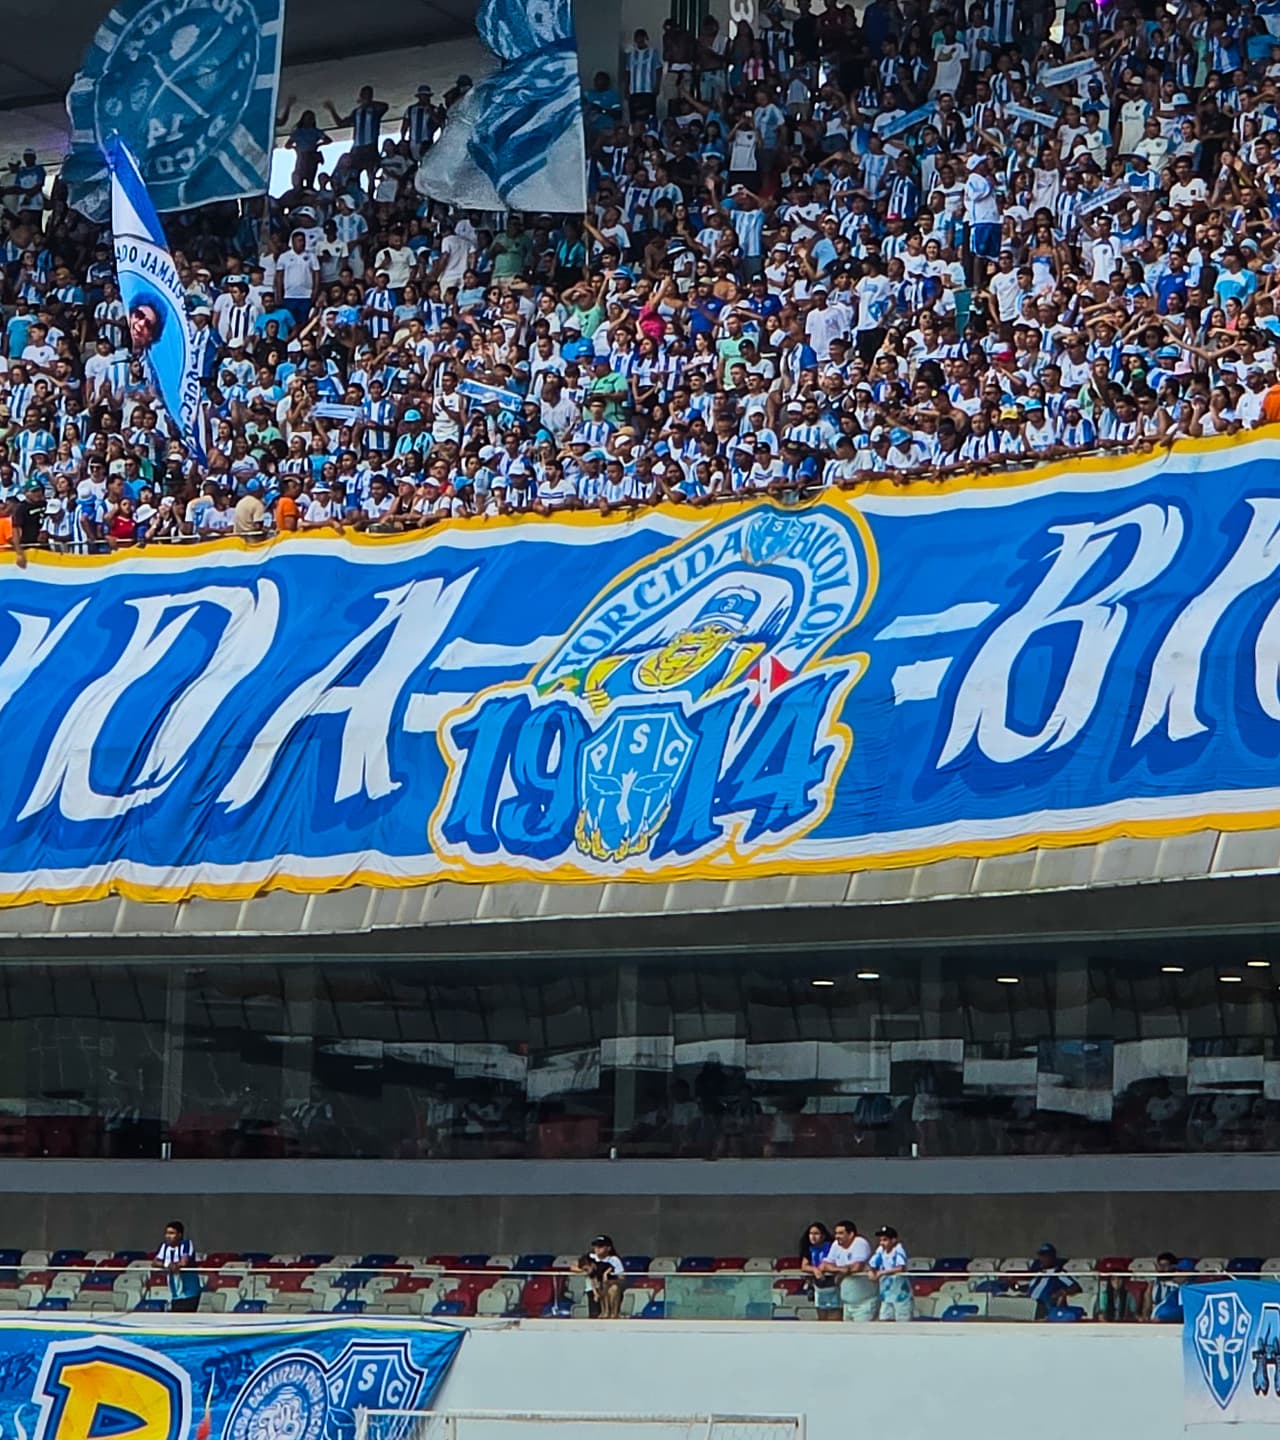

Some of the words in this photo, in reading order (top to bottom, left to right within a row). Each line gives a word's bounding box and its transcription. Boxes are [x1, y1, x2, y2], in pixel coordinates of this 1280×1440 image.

[551, 528, 744, 674] TORCIDA
[777, 522, 852, 654] BICOLOR
[330, 1363, 404, 1405] PSC
